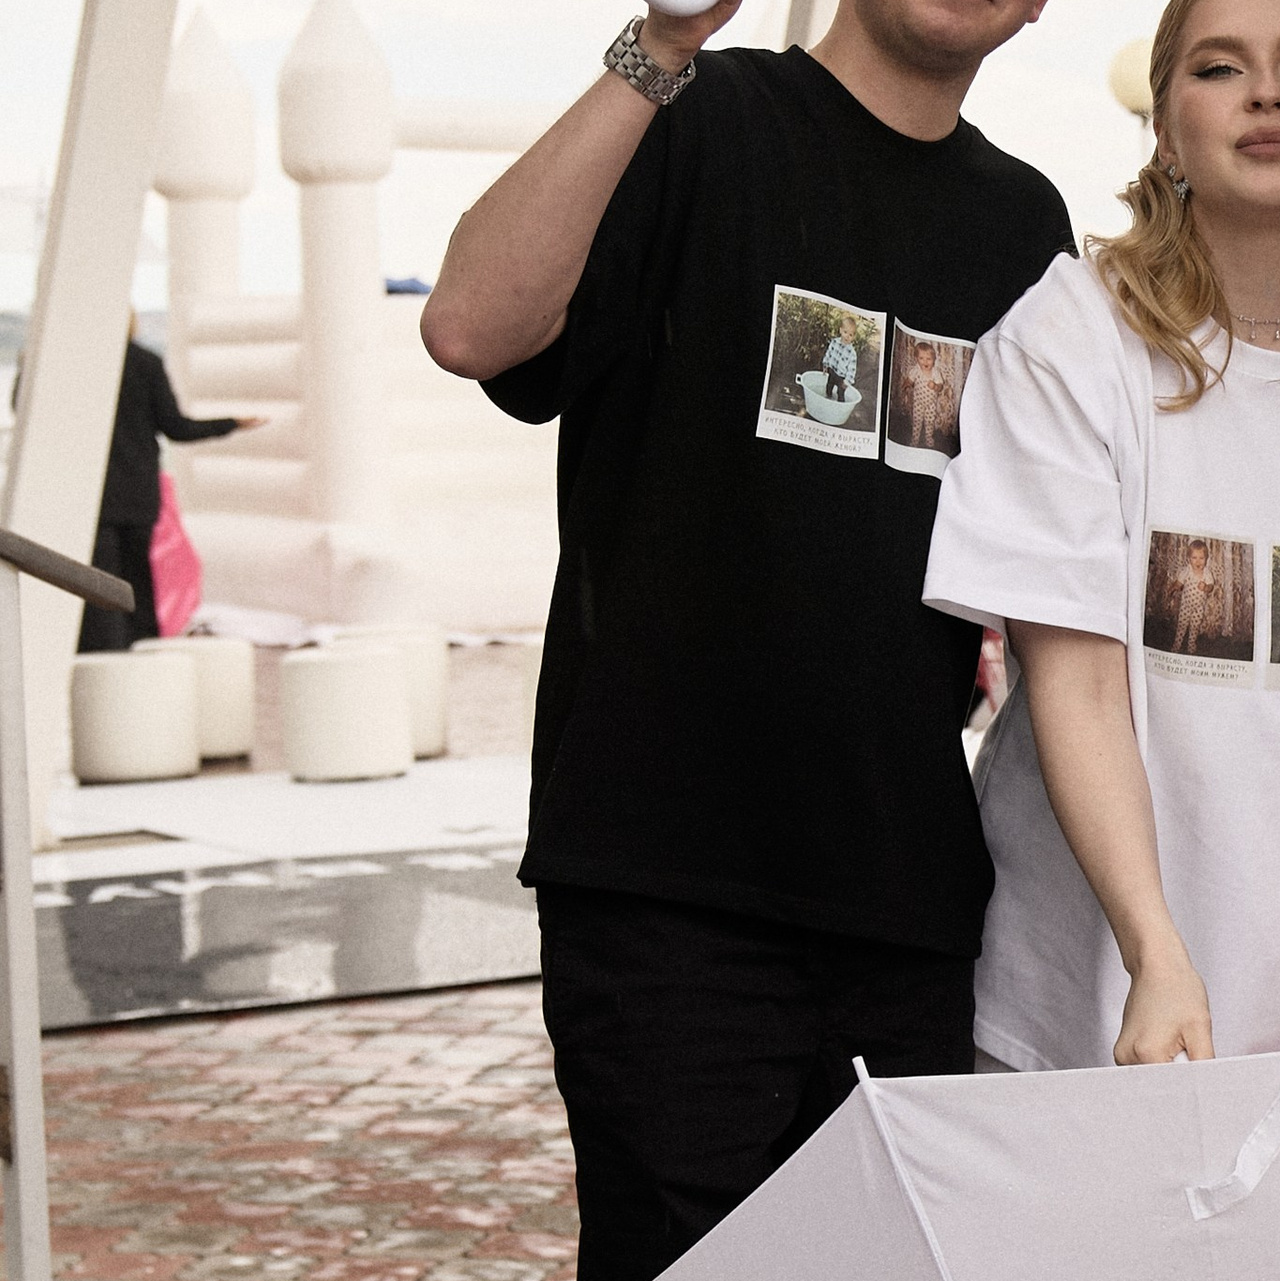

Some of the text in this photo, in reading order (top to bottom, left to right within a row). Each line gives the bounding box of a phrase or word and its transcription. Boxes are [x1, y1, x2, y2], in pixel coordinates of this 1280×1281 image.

[775, 428, 787, 437] КТО
[790, 431, 812, 443] БУДЕТ
[1154, 662, 1165, 671] КТО
[1167, 666, 1188, 675] БУДЕТ
